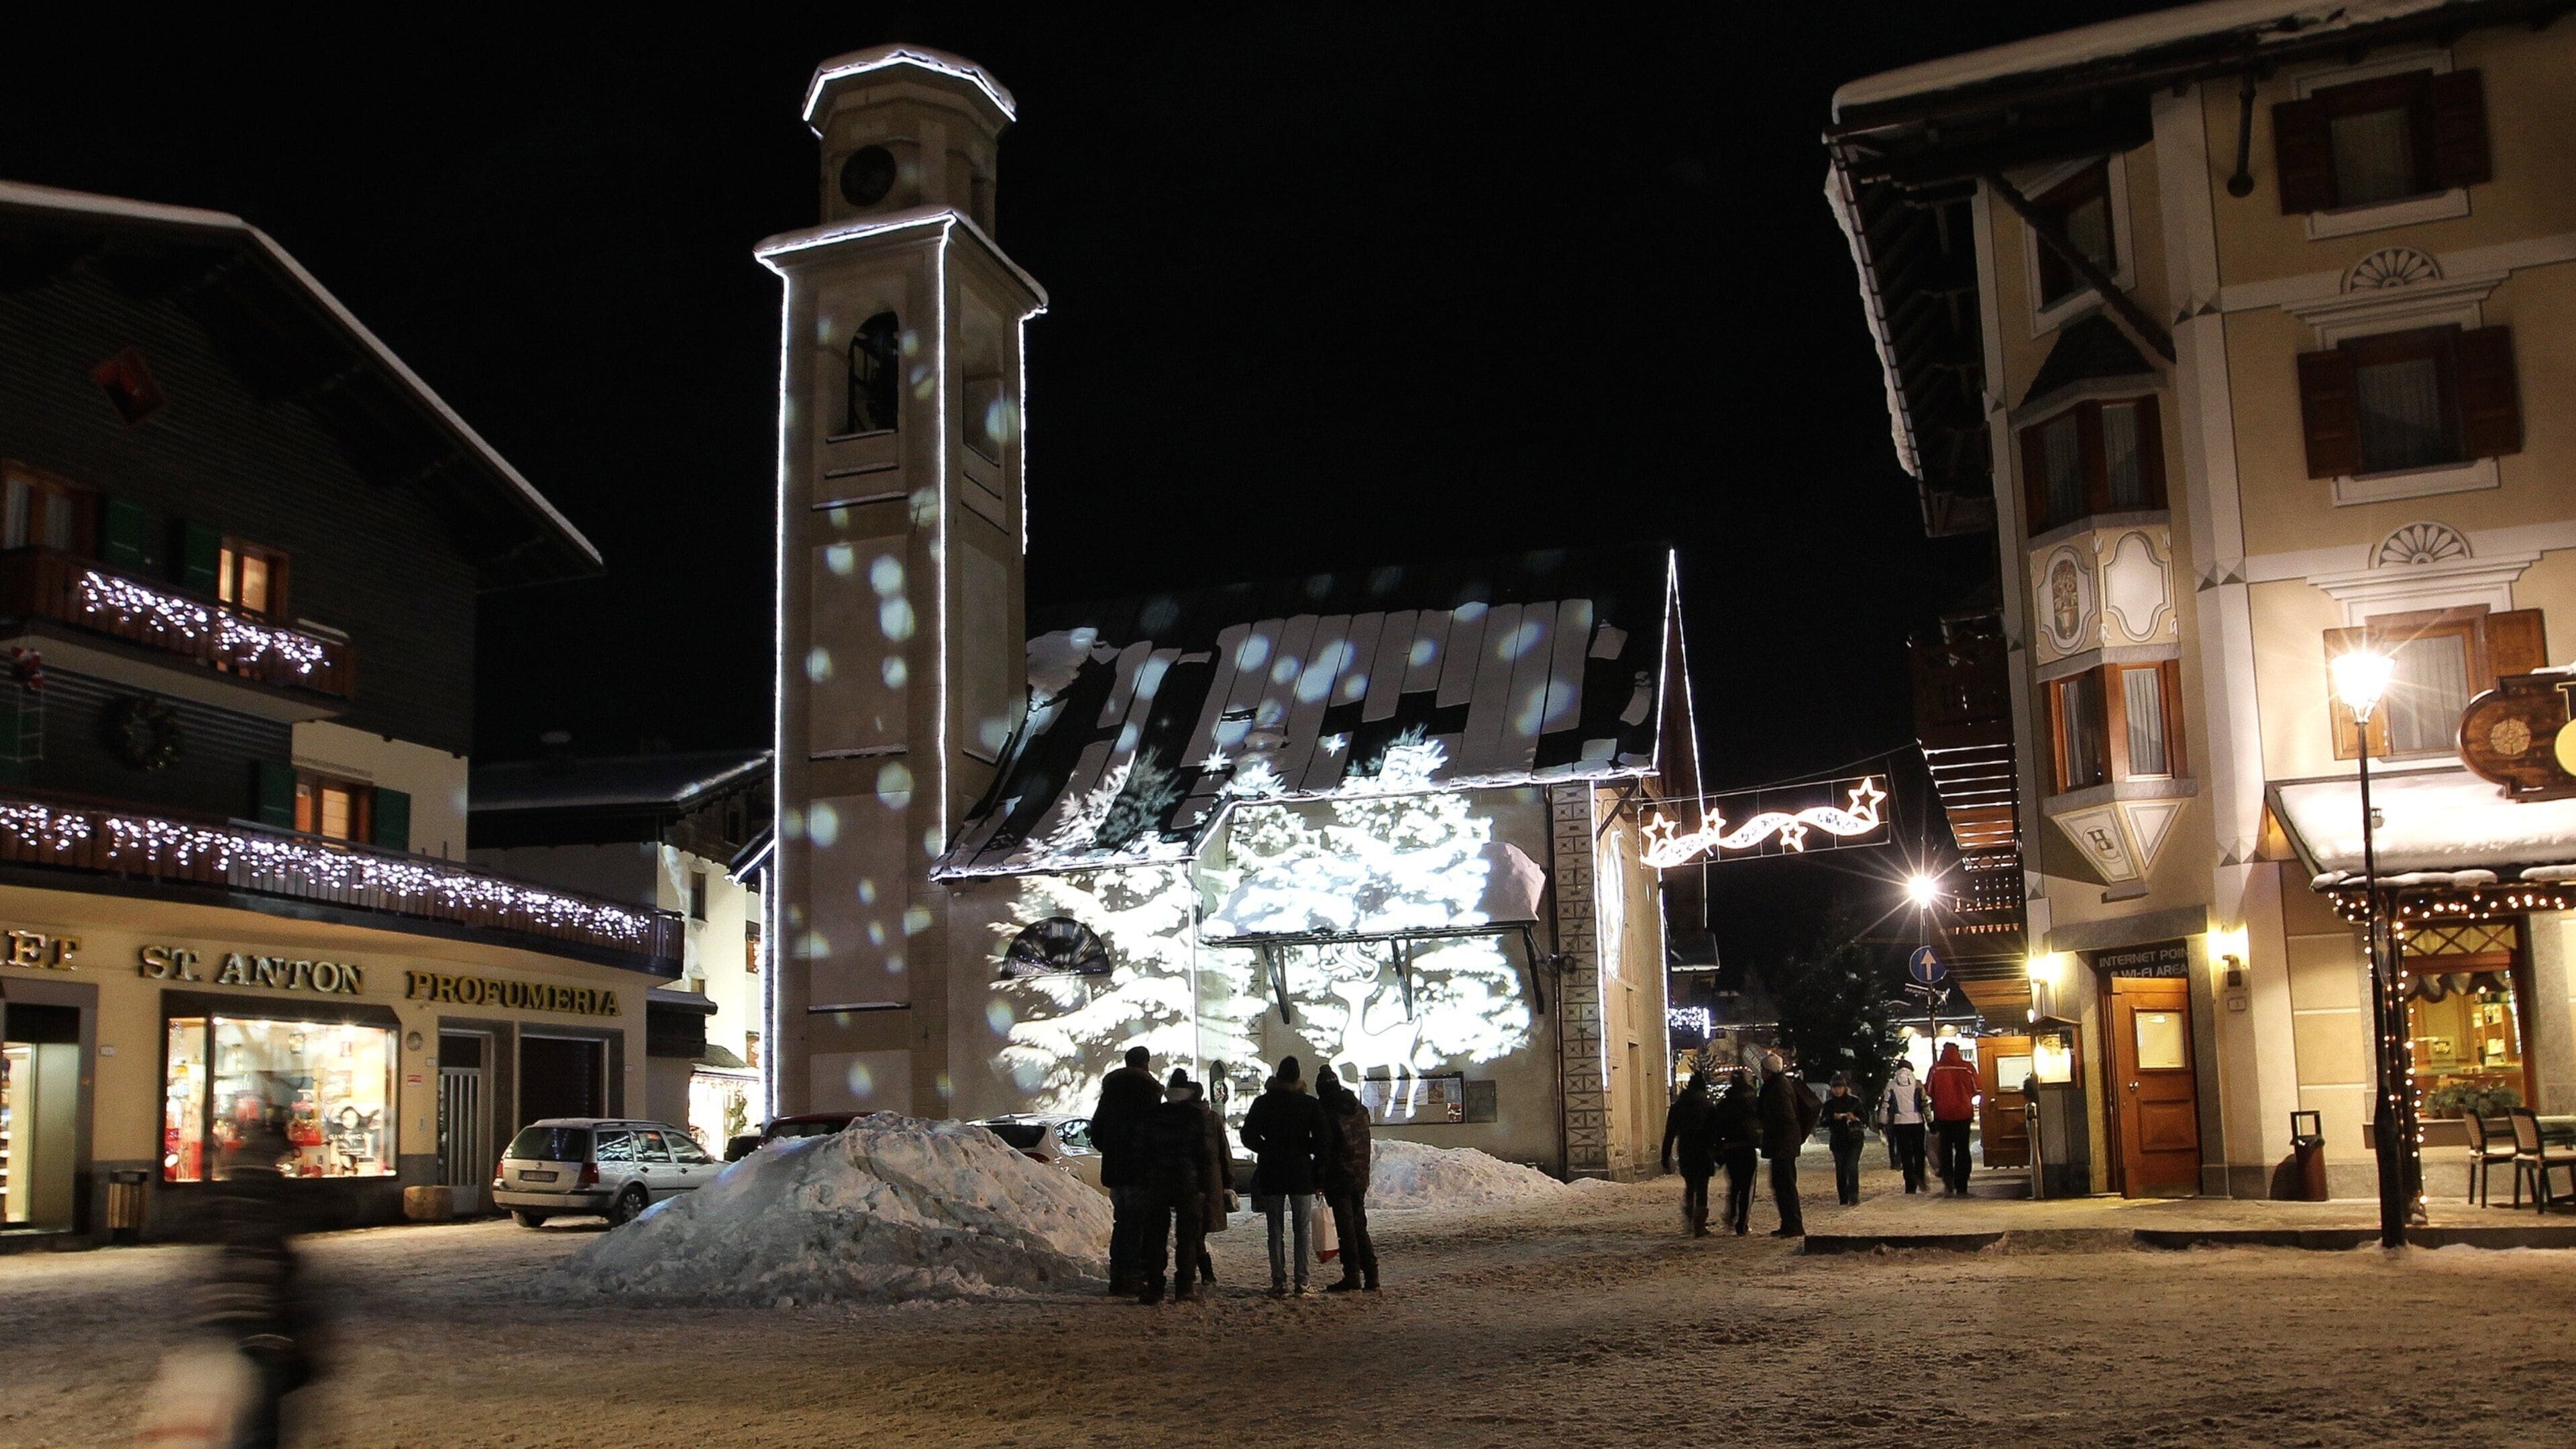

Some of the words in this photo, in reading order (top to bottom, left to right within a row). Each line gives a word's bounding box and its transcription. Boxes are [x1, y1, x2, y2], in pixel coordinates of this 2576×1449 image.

[217, 952, 366, 995] ANTON
[2099, 951, 2156, 968] INTERNET
[2156, 964, 2188, 977] AREA
[406, 970, 623, 1016] PROFUMERIA
